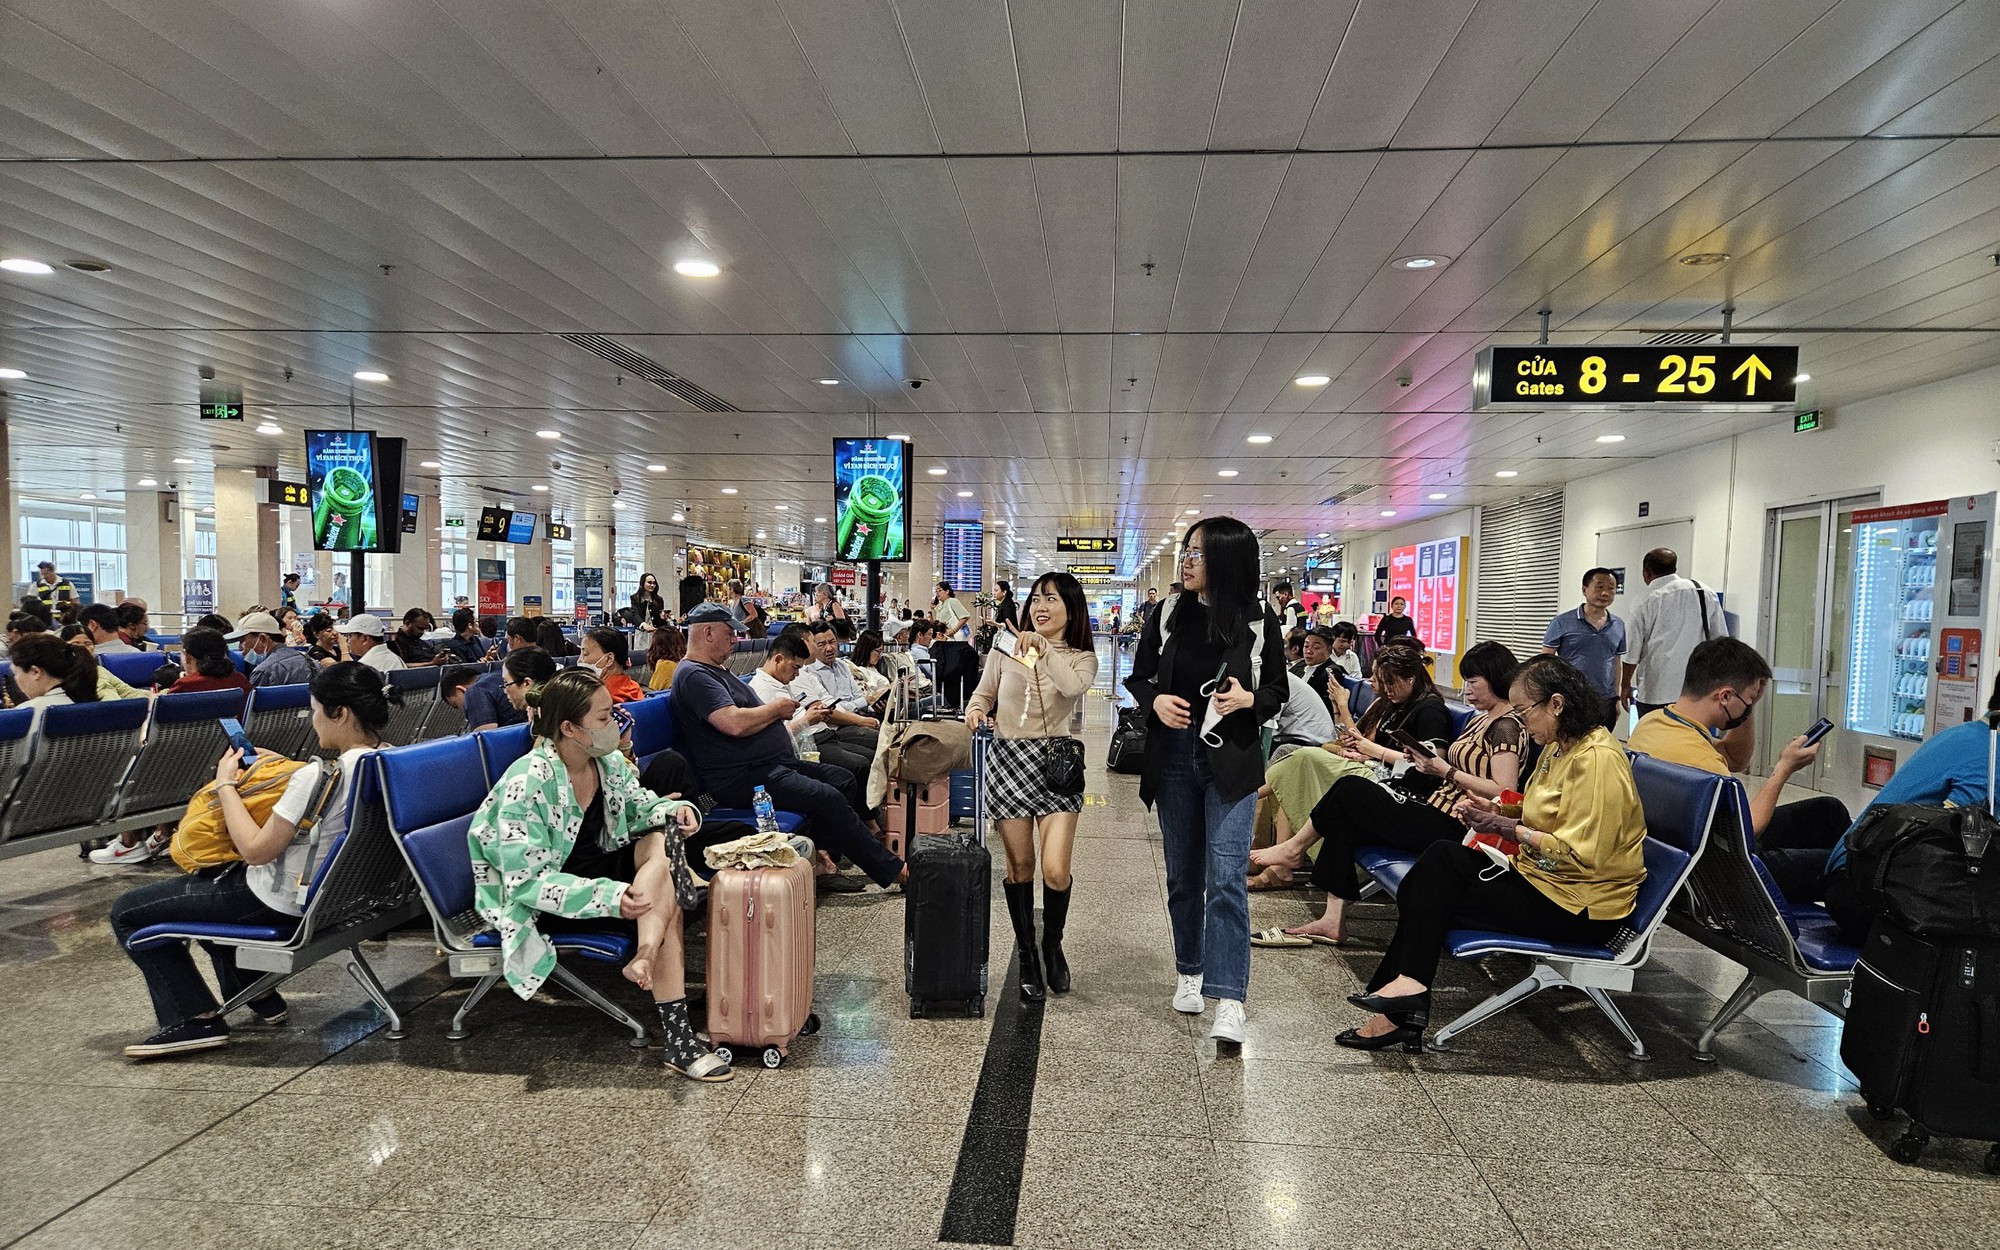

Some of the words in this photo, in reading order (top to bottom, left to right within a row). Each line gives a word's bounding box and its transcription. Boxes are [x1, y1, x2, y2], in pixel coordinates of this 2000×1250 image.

[1517, 355, 1557, 376] CỬA
[1579, 356, 1607, 394] 8
[1656, 355, 1716, 394] 25
[1516, 381, 1564, 395] Gates
[1800, 413, 1813, 424] EXIT
[300, 488, 307, 504] 8
[498, 517, 506, 533] 9
[480, 602, 505, 610] PRIORITY
